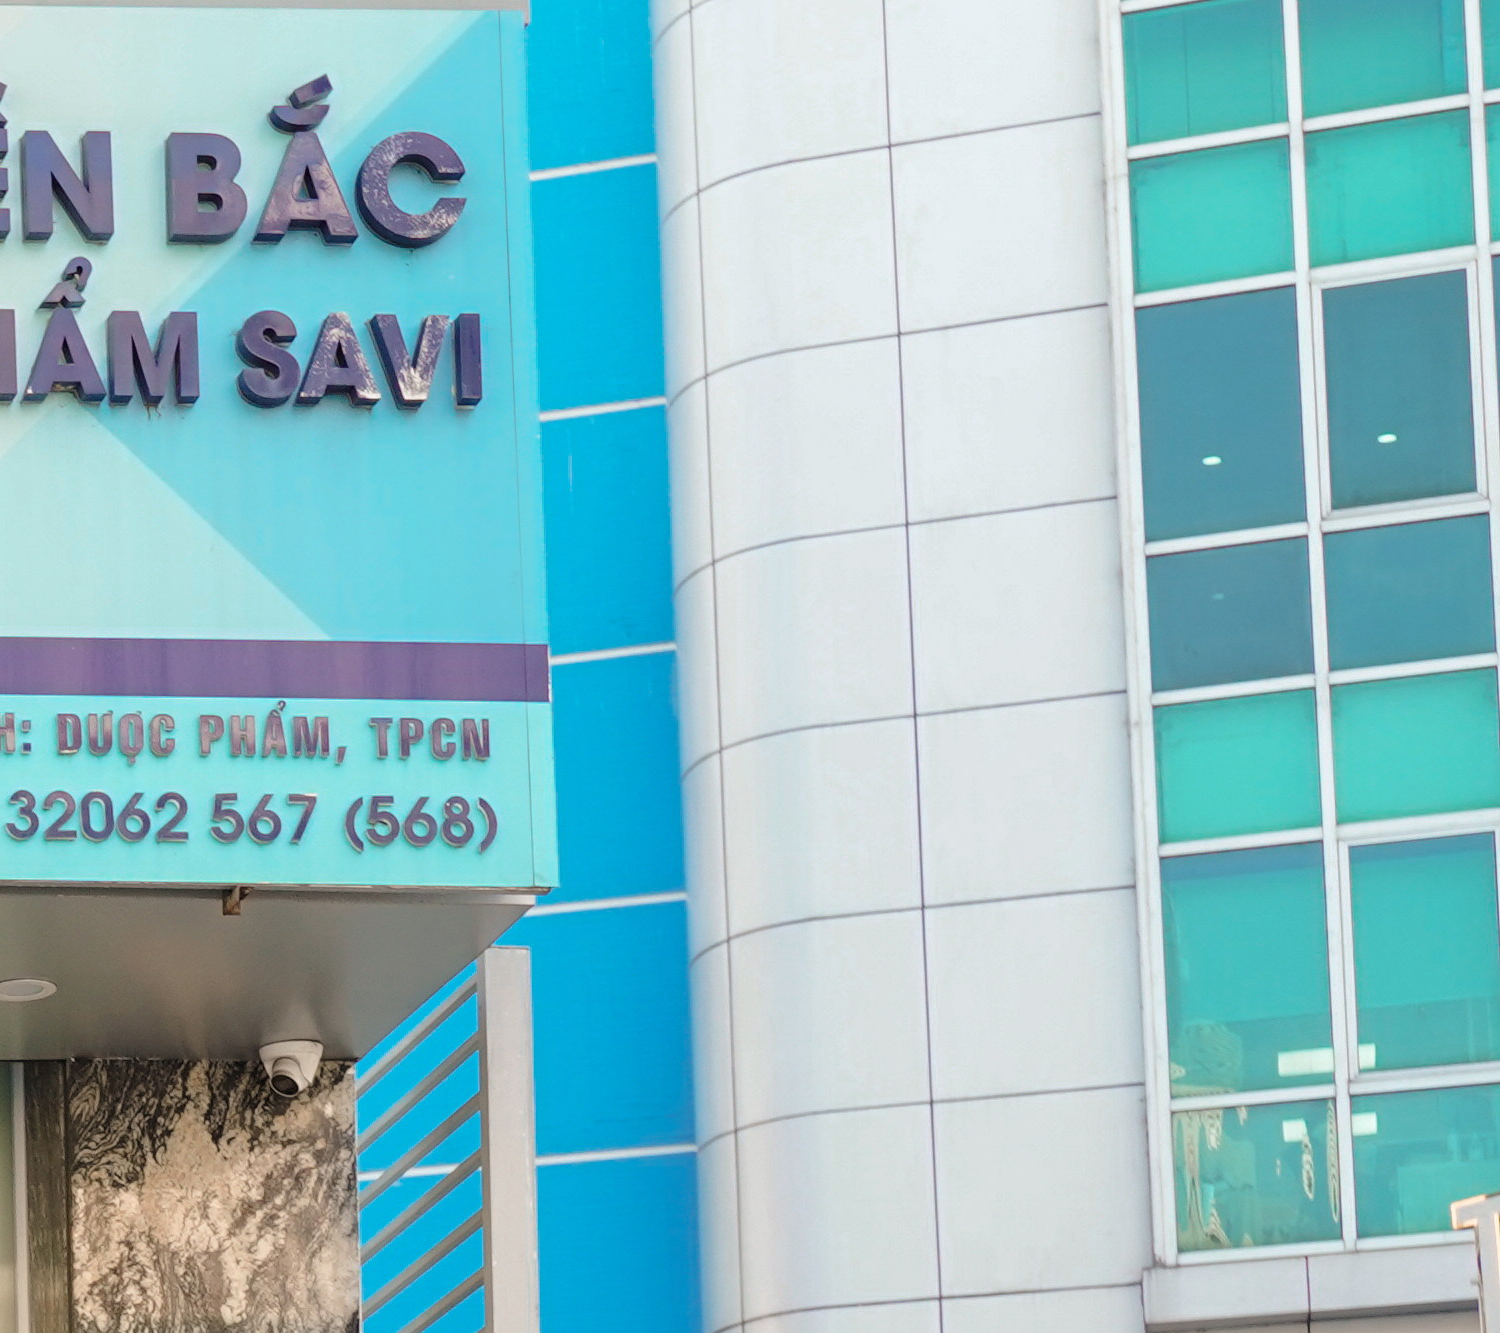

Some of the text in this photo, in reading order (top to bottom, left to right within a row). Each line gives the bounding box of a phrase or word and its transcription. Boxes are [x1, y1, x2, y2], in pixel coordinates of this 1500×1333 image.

[166, 73, 468, 249] BẮC
[236, 309, 483, 410] SAVI
[56, 710, 177, 764] DƯỢC
[199, 699, 347, 764] PHẨM,
[370, 716, 491, 762] TPCN
[5, 790, 190, 844] 32062
[209, 791, 318, 846] 567
[344, 794, 499, 853] (568)
